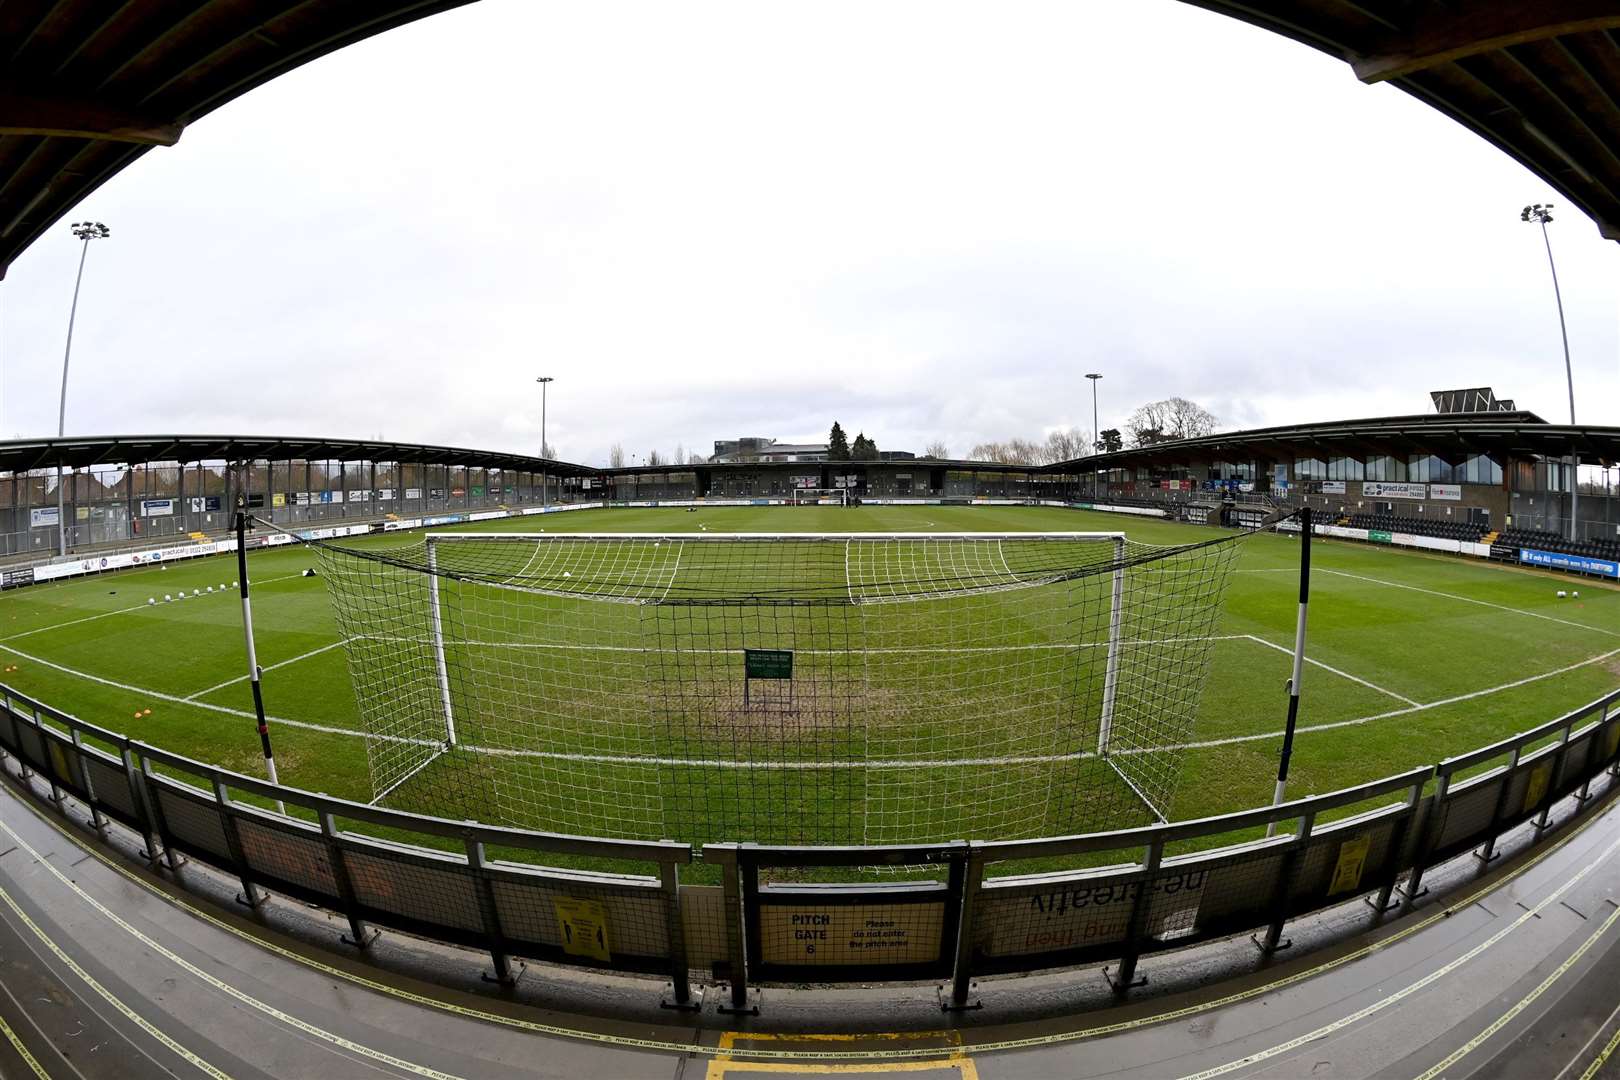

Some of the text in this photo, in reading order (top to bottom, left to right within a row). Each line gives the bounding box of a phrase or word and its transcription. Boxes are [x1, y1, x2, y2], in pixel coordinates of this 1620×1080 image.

[792, 914, 830, 925] PITCH
[795, 930, 827, 940] GATE
[807, 944, 815, 954] 6
